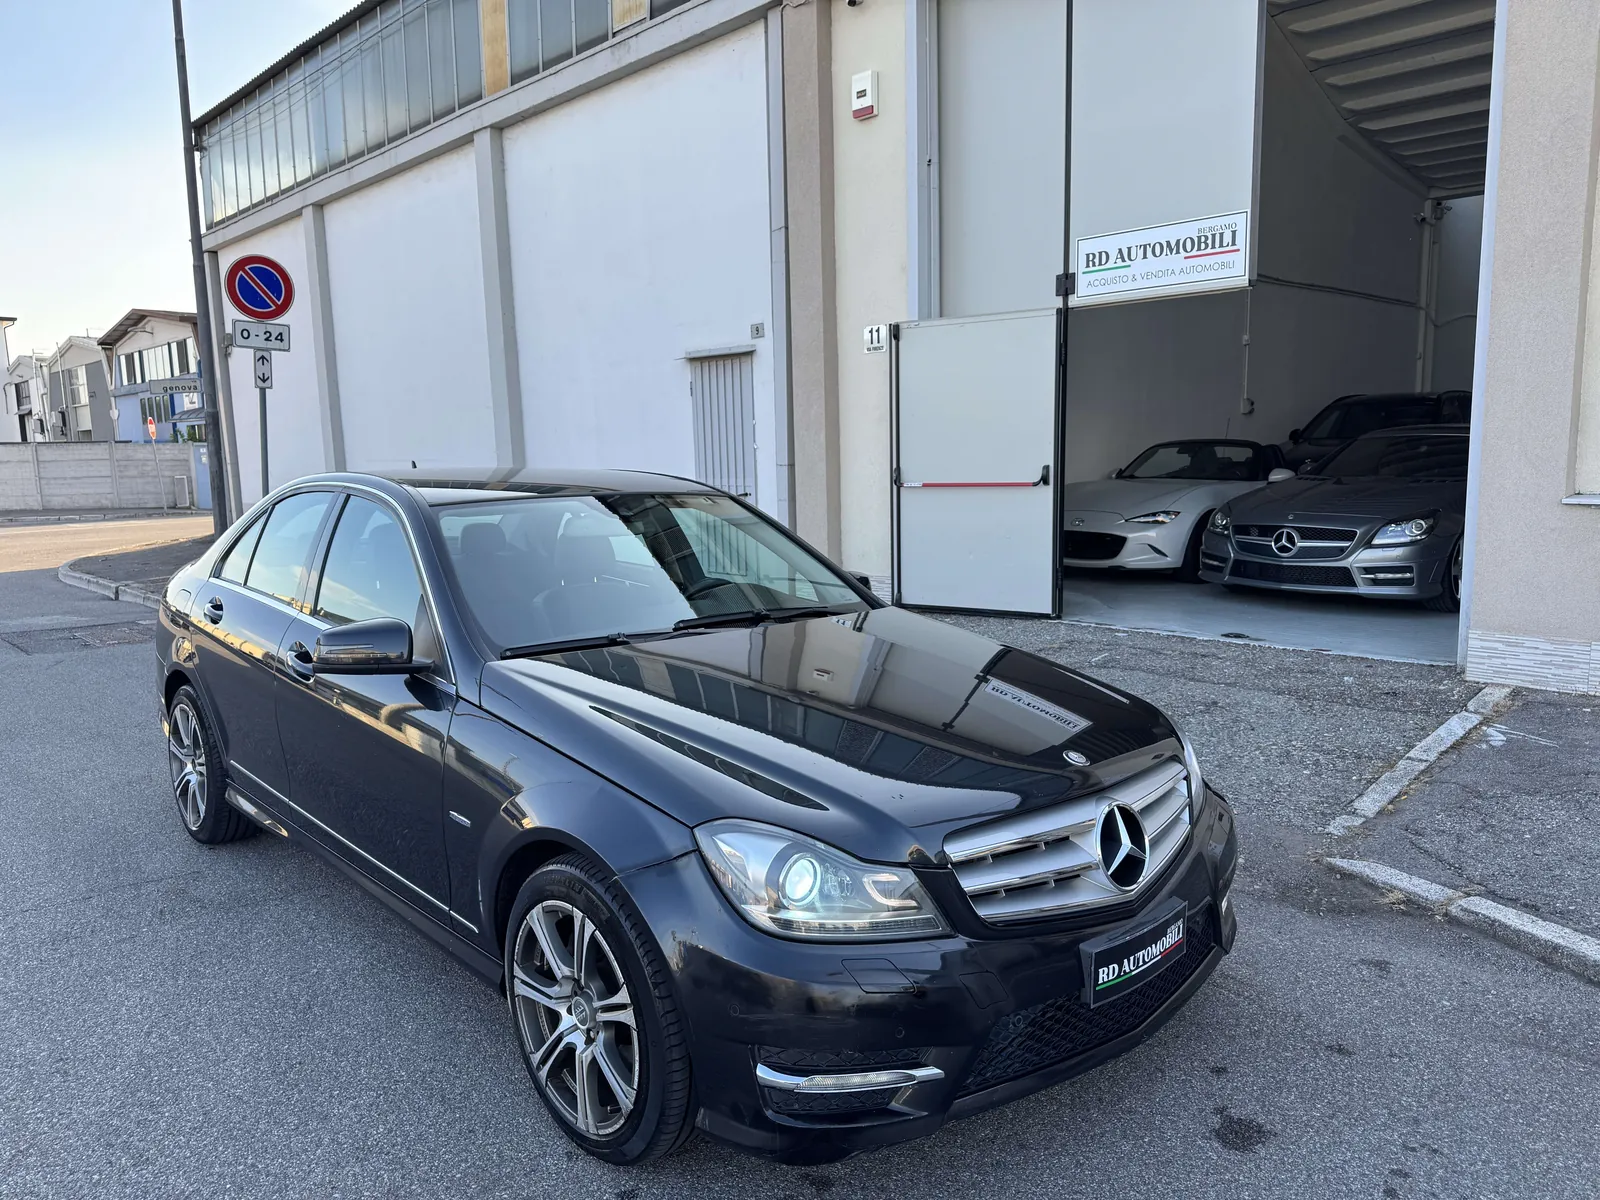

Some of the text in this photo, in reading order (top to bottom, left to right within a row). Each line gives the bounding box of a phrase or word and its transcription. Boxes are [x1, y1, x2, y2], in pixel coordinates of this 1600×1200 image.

[1197, 222, 1237, 234] BERGAMO
[1084, 230, 1238, 268] RD AUTOMOBILI
[1086, 260, 1235, 288] ACQUISTO & VENDITA AUTOMOBILI
[263, 330, 284, 343] 24
[868, 326, 880, 345] 11
[162, 384, 198, 393] genova
[1098, 924, 1183, 984] RD AUTOMOBILI
